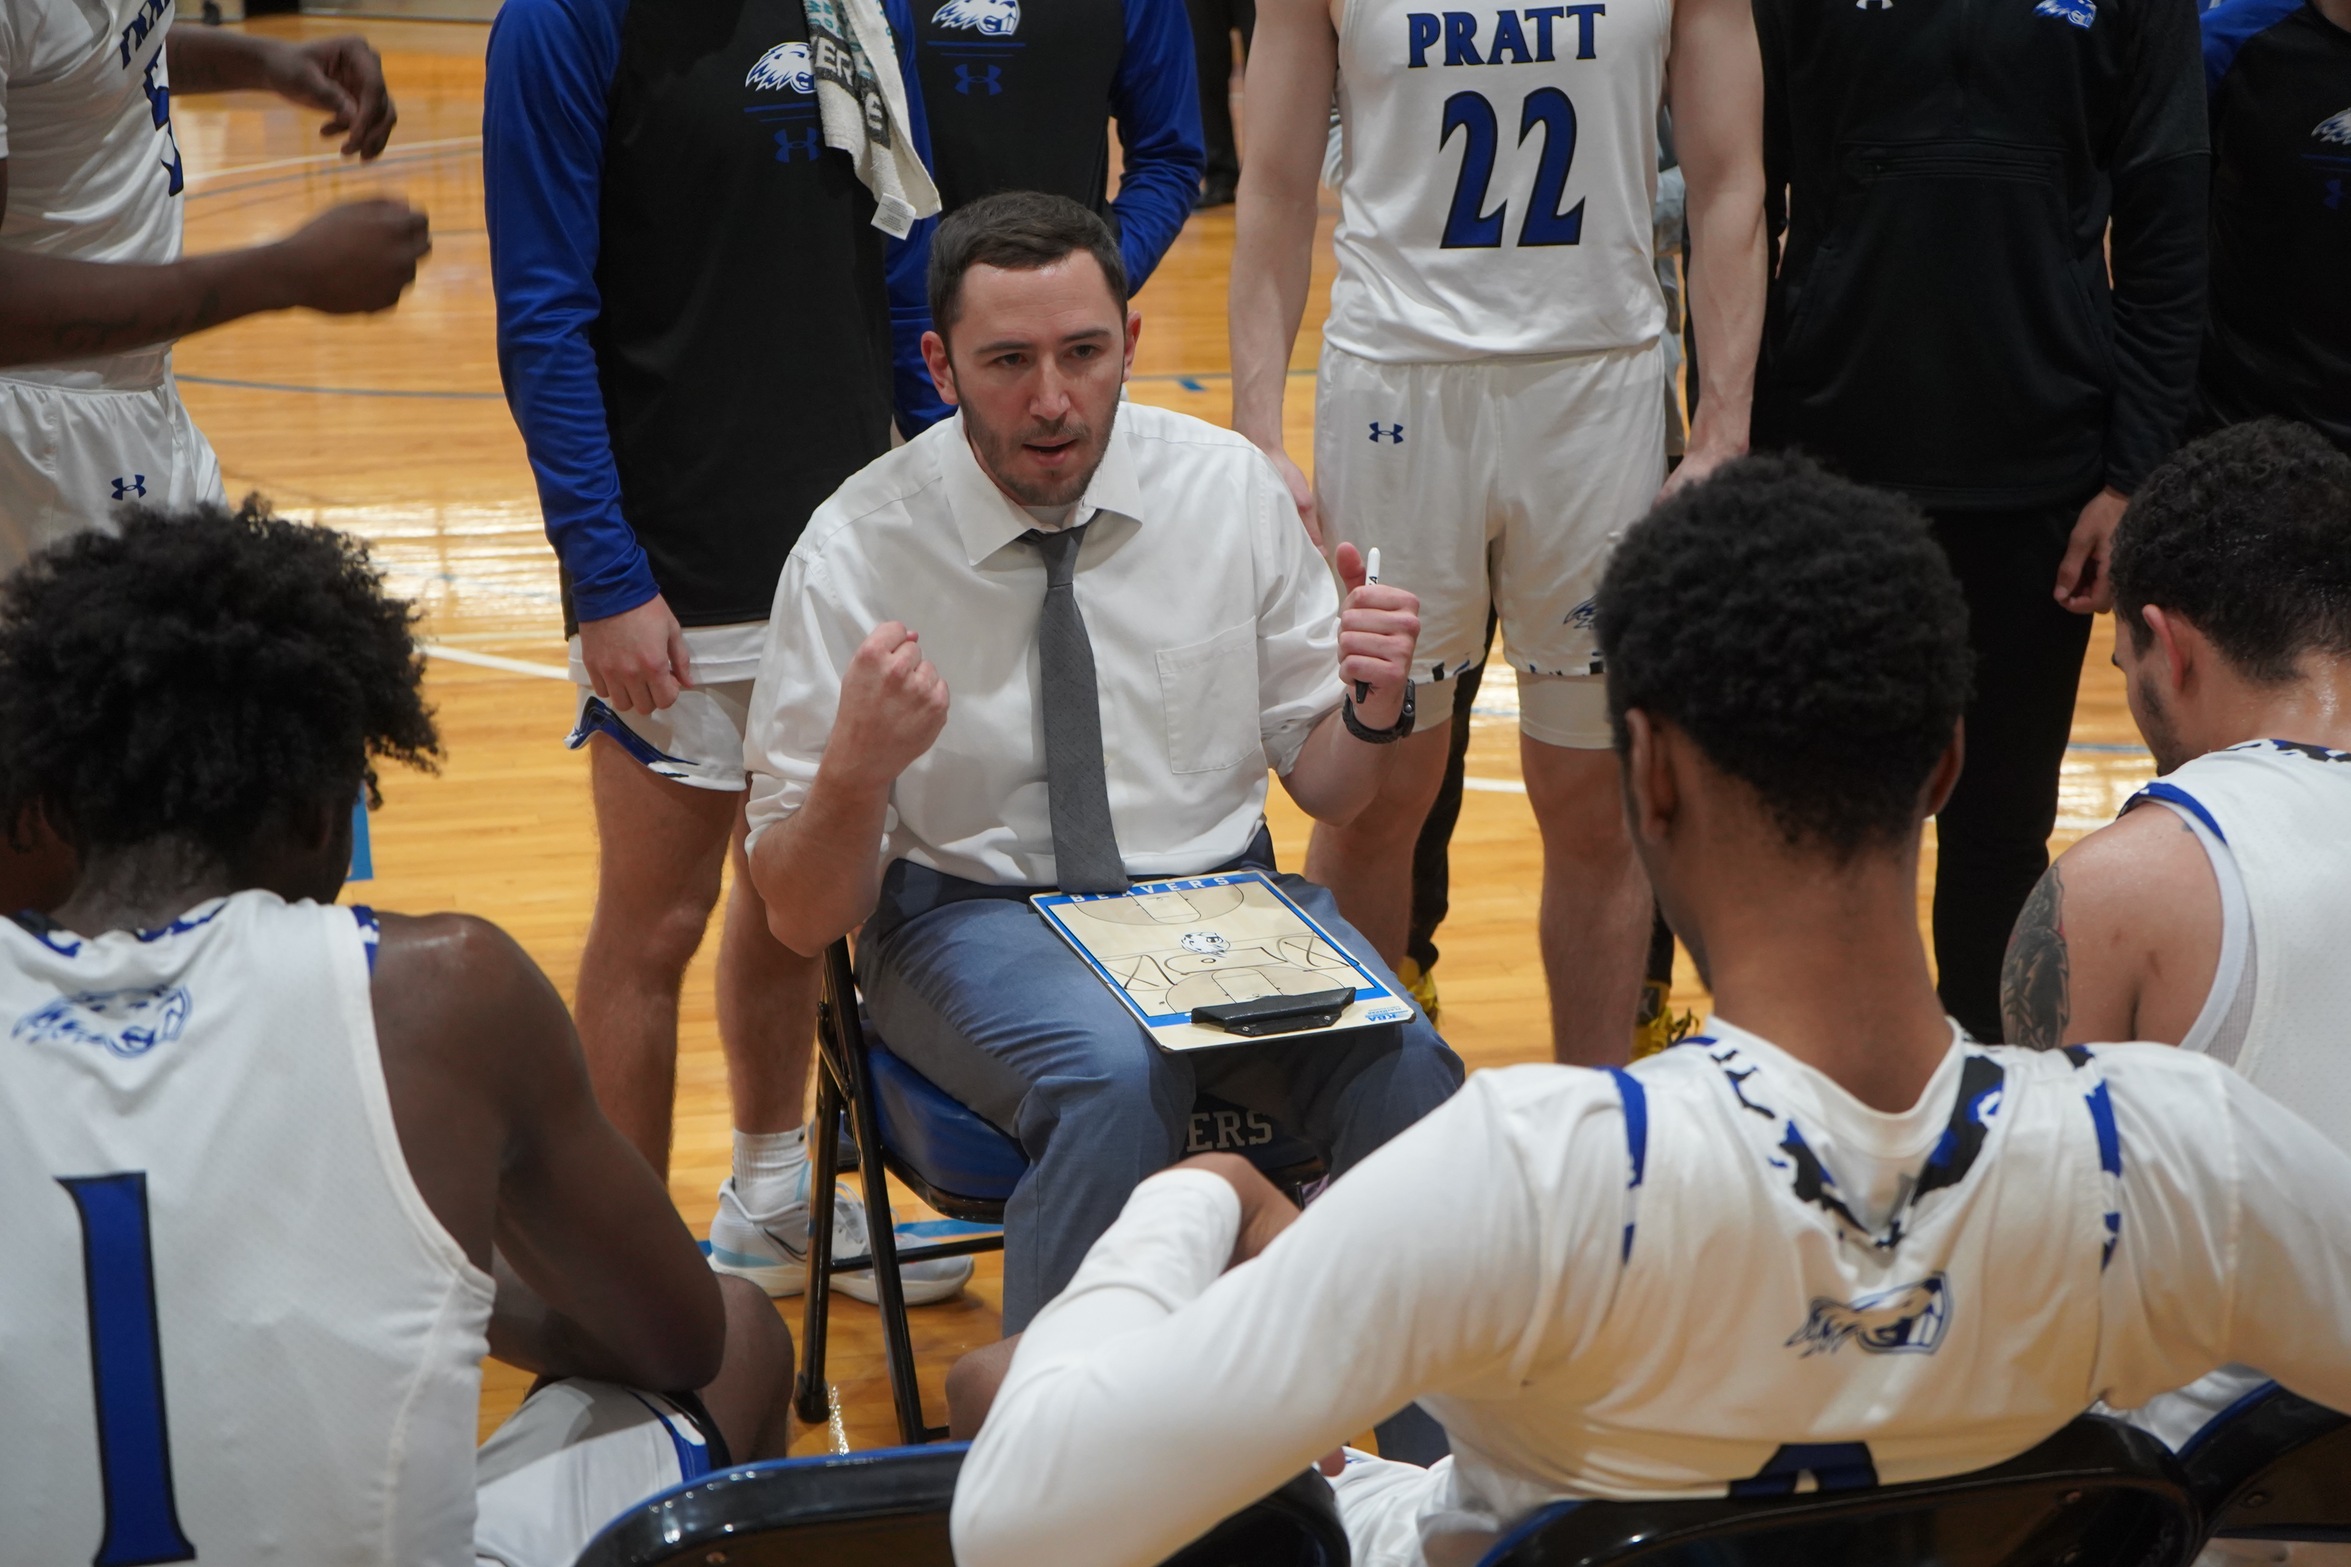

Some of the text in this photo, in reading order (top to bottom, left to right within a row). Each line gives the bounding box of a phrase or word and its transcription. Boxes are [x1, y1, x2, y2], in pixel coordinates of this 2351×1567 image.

[1407, 4, 1606, 68] PRATT
[1439, 86, 1586, 249] 22
[1186, 1109, 1273, 1152] ERS
[52, 1171, 197, 1567] 1
